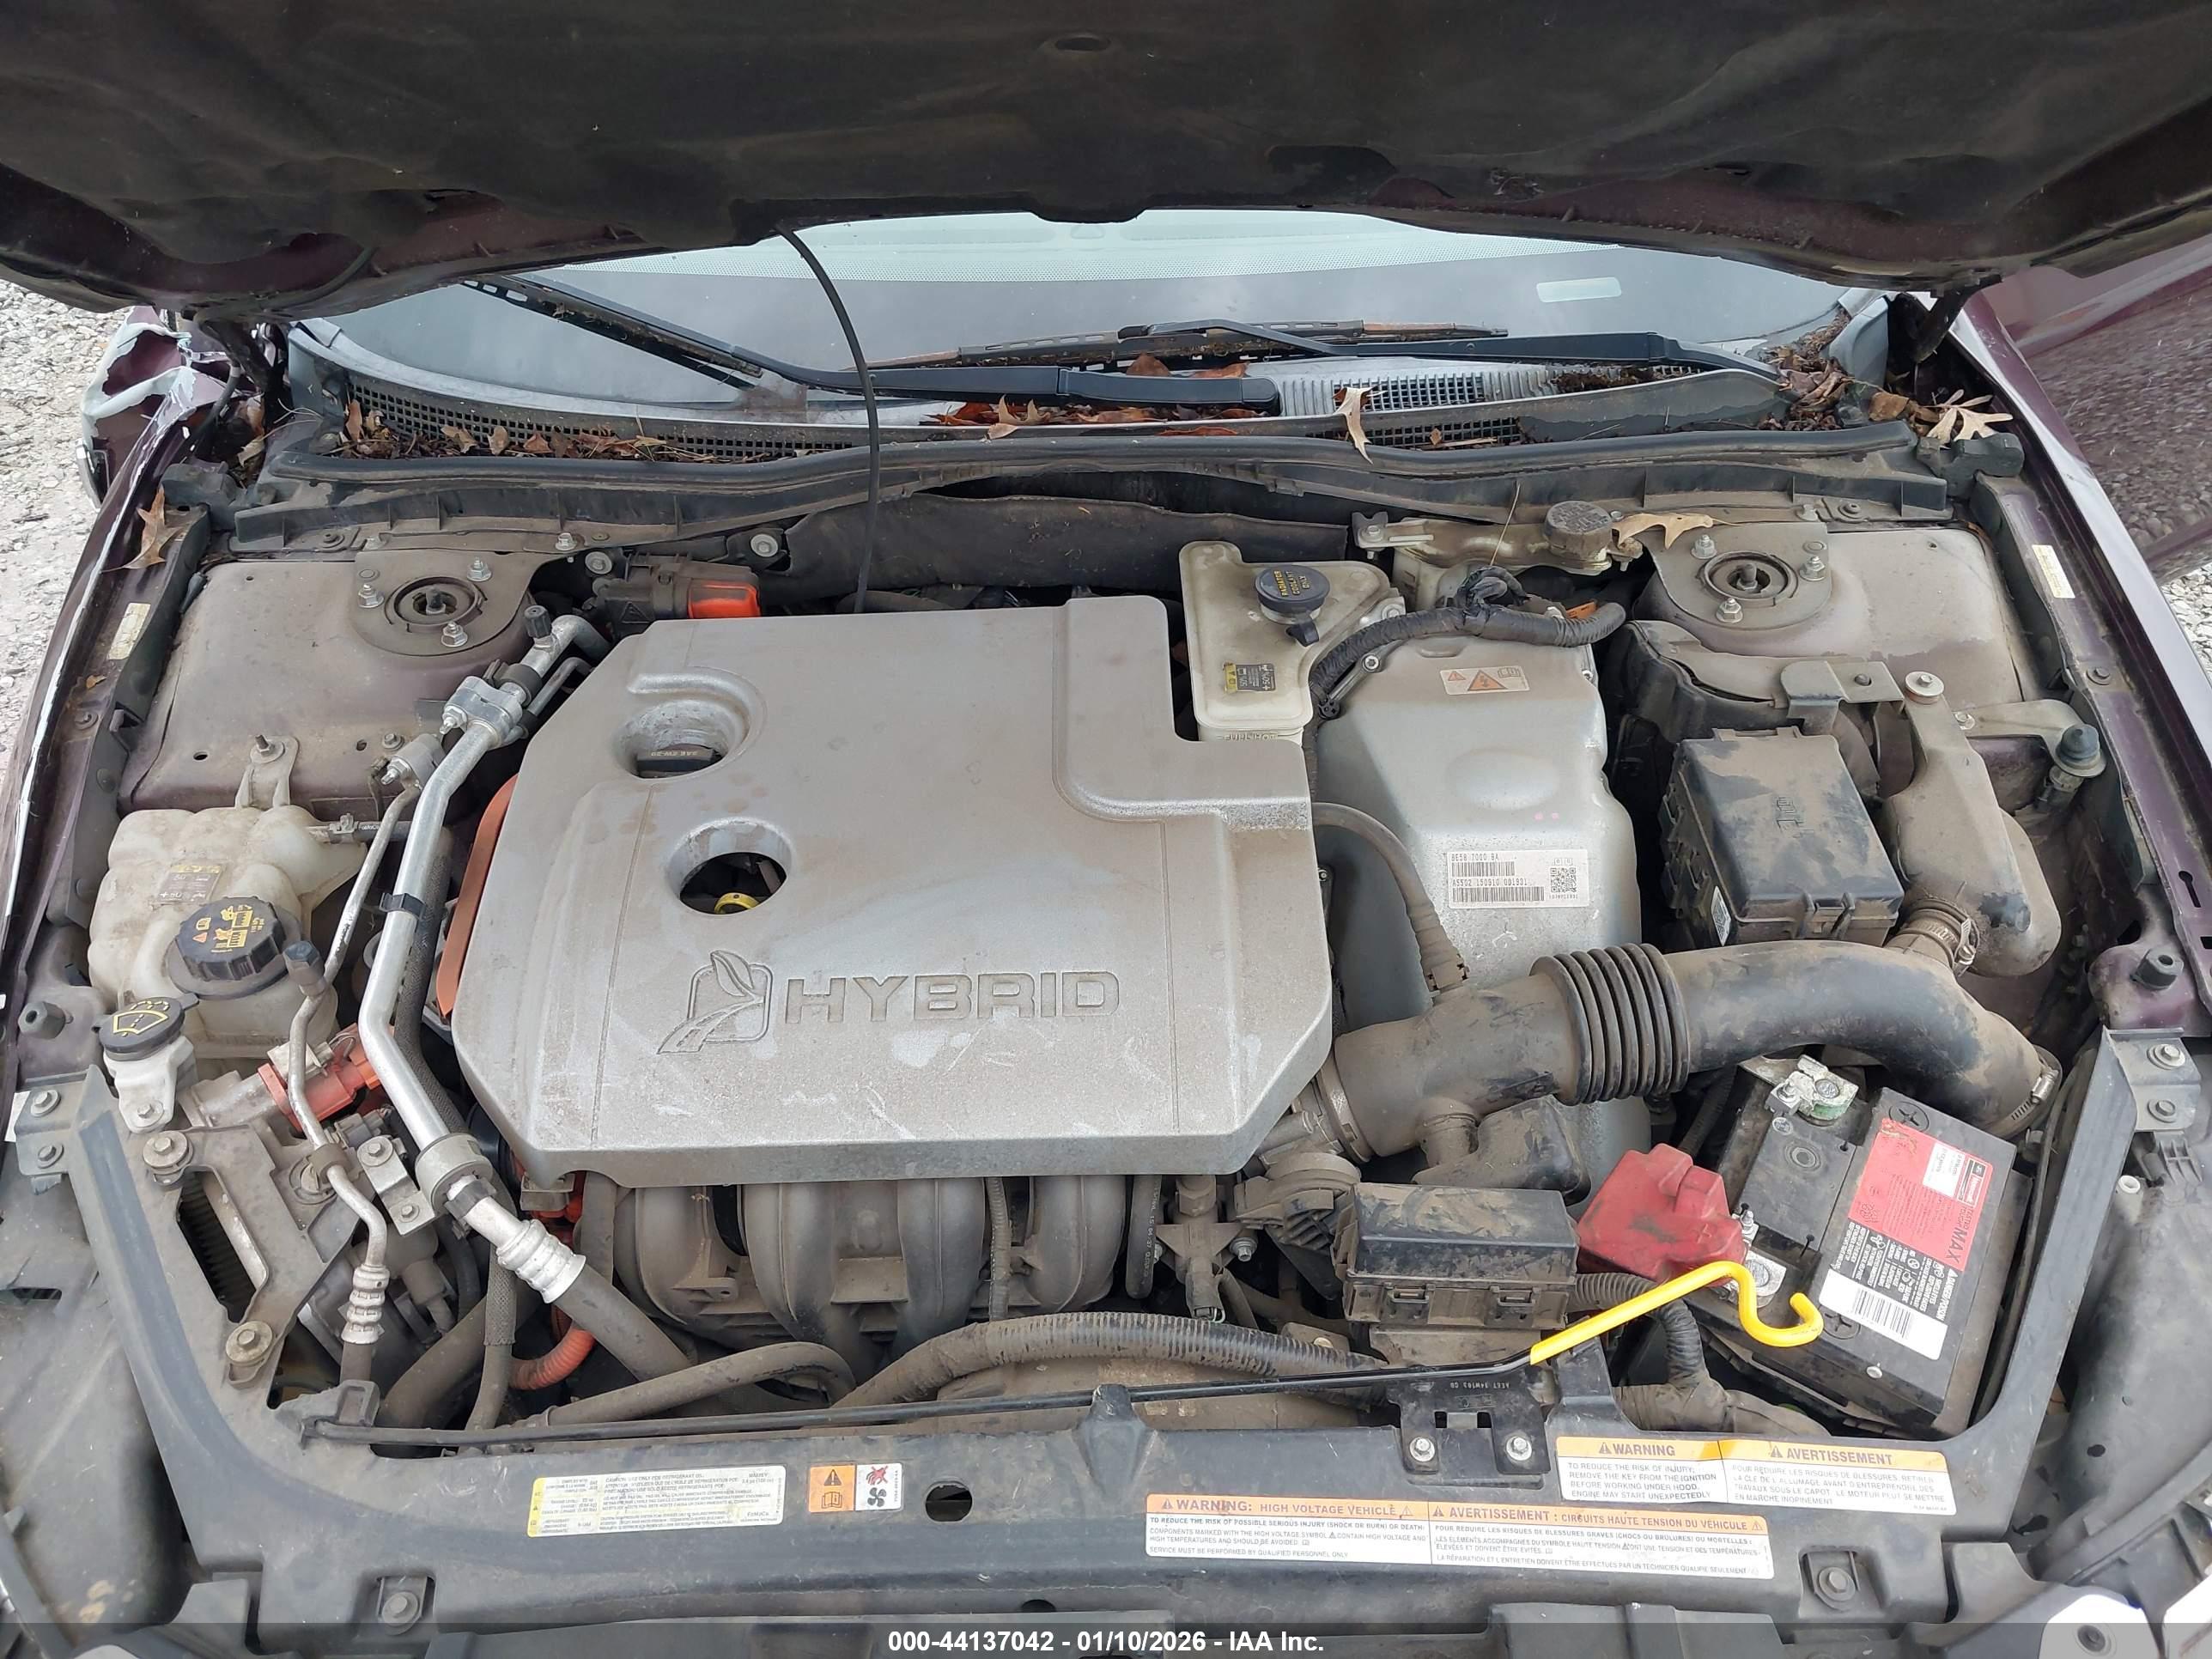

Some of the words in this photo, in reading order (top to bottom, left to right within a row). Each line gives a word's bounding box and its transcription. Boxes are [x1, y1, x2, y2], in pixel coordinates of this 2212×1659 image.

[785, 970, 1120, 1024] HYBRID
[1946, 1226, 1968, 1263] MAX
[1613, 1443, 1675, 1456] WARNING
[1787, 1448, 1893, 1465] AVERTISSEMENT
[1680, 1473, 1717, 1481] IGNITION
[1604, 1481, 1641, 1490] WORKING
[1176, 1498, 1252, 1511] WARNING:
[1260, 1504, 1289, 1512] HIGH
[1292, 1504, 1344, 1514] VOLTAGE
[1347, 1505, 1396, 1516] VEHICLE
[1449, 1507, 1550, 1522] AVERTISSEMENT
[1561, 1514, 1605, 1524] CIRCUITS
[1607, 1516, 1639, 1526] HAUTE
[1641, 1517, 1682, 1528] TENSION
[1150, 1527, 1194, 1535] COMPONENTS
[1707, 1536, 1747, 1545] MORTELLES
[1643, 1563, 1680, 1571] TECHNICIEN
